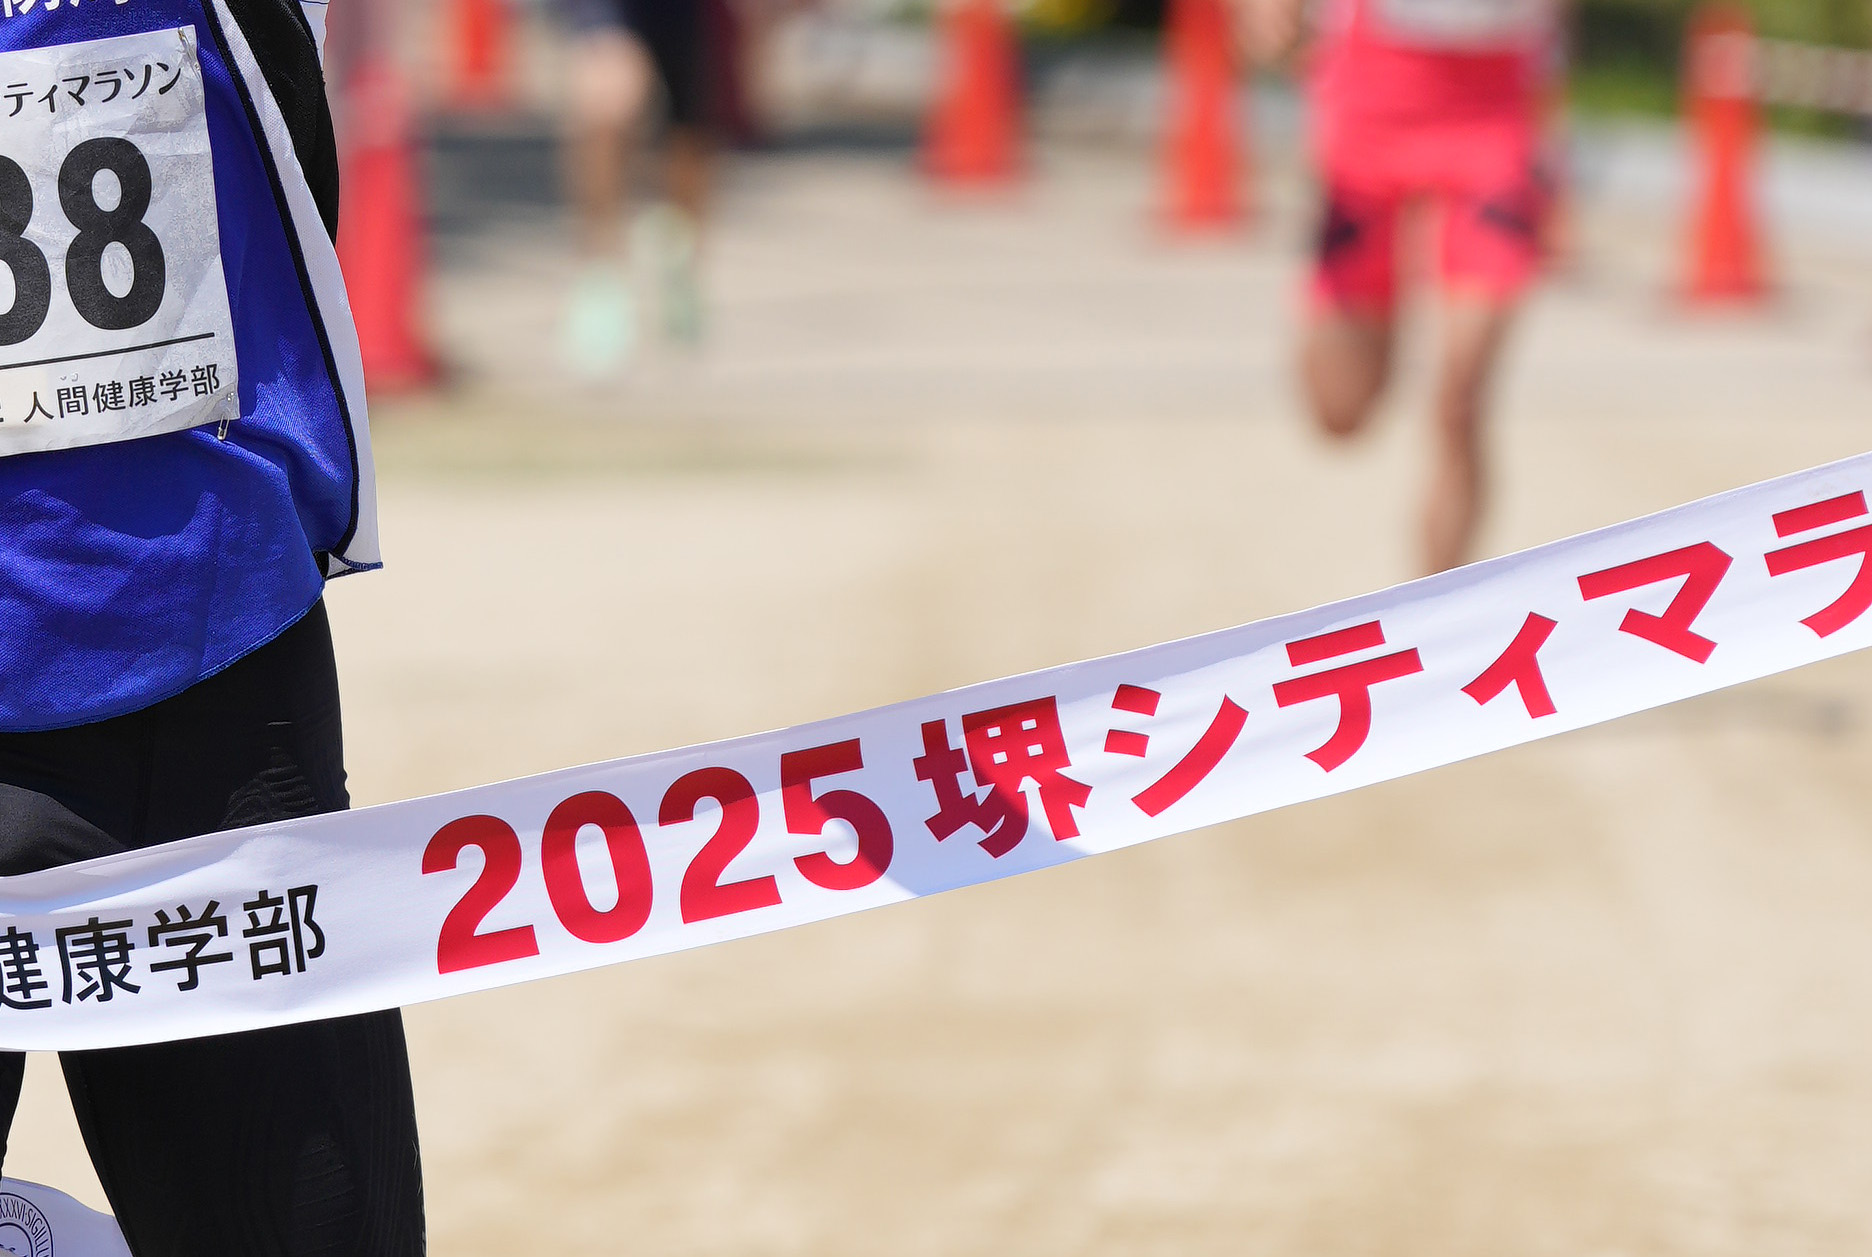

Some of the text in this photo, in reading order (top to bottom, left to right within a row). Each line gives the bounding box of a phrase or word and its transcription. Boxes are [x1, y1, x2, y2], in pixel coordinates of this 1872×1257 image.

[23, 363, 221, 424] 人間健康学部
